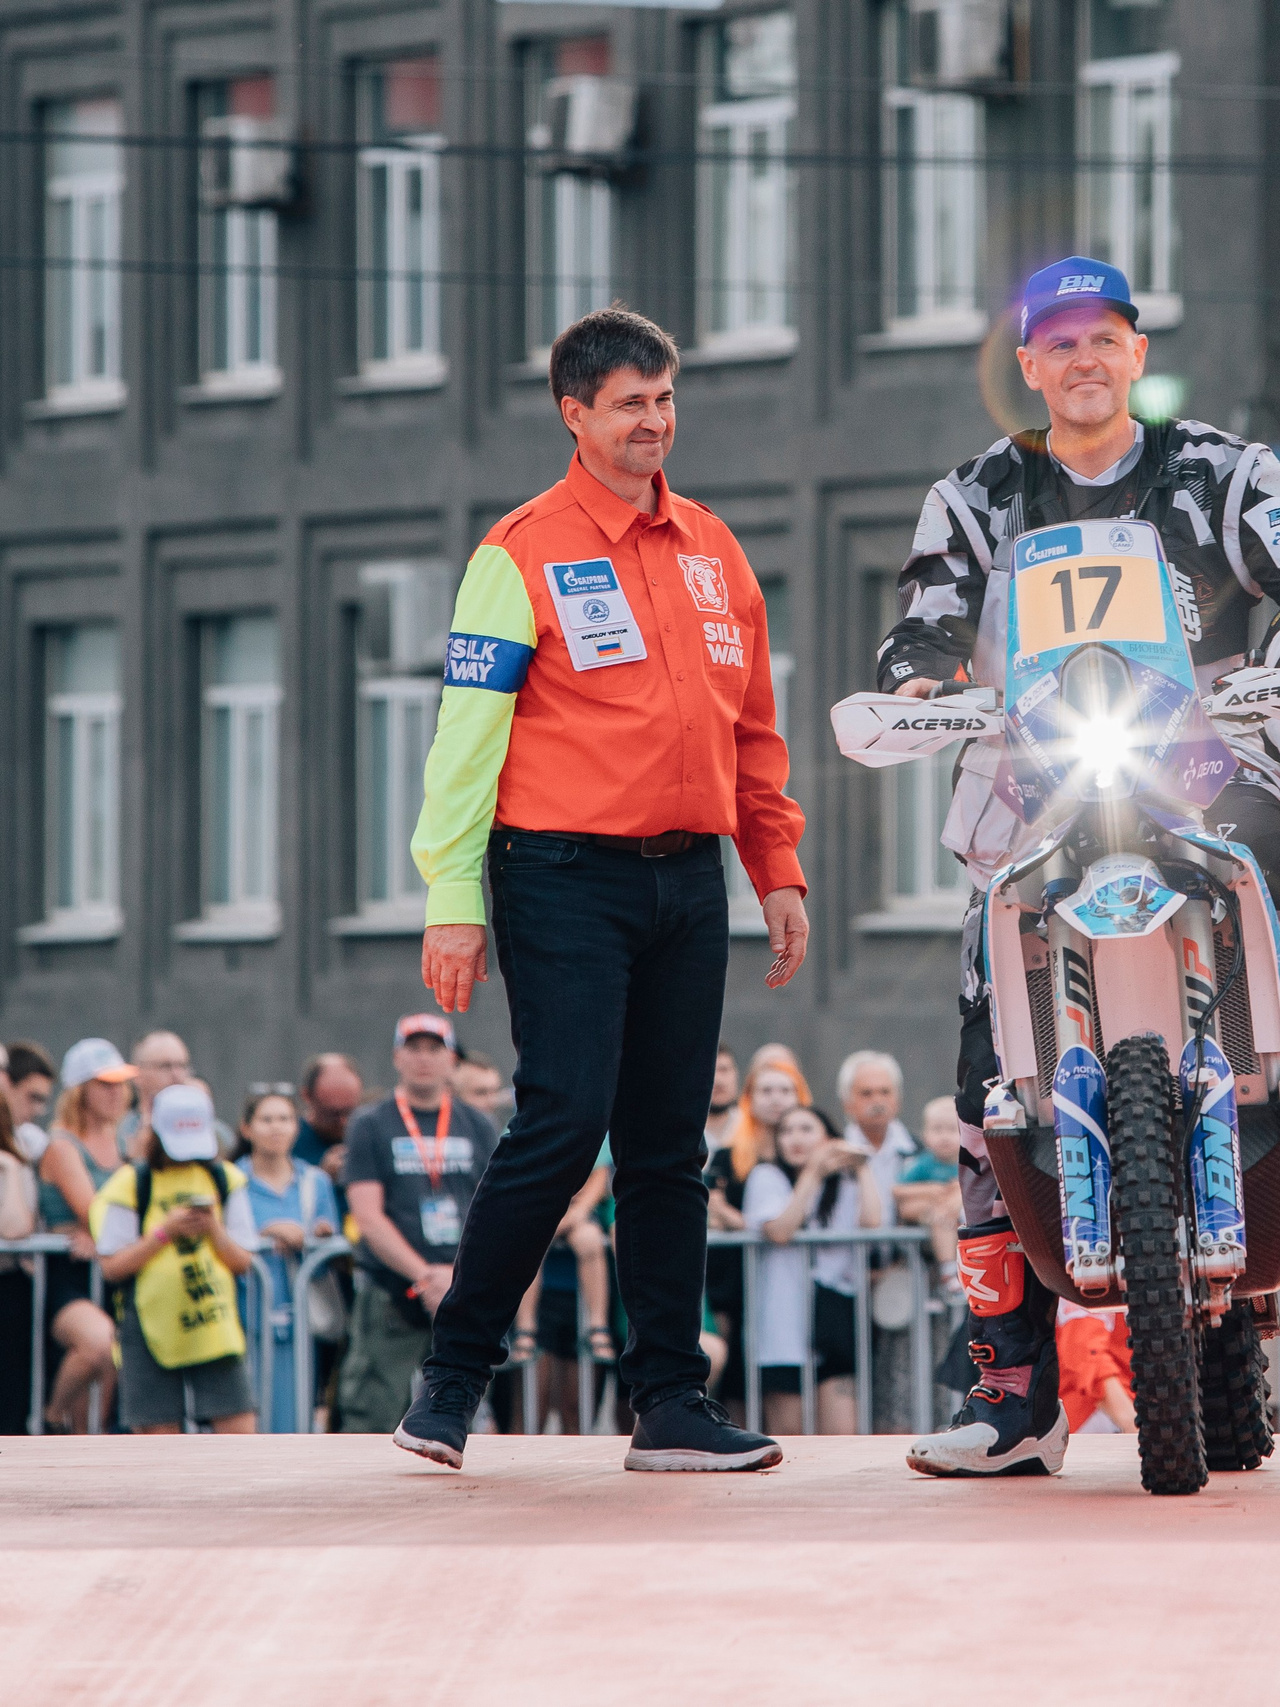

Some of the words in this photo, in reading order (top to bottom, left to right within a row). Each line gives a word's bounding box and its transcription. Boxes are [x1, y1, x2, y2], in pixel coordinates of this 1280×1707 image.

[1056, 287, 1101, 296] RACING
[1059, 275, 1106, 289] BN
[1036, 544, 1068, 561] GAZPROM
[577, 574, 609, 585] GAZPROM
[1050, 565, 1122, 634] 17
[703, 621, 744, 647] SILK
[451, 638, 499, 662] SILK
[706, 642, 744, 668] WAY
[450, 660, 495, 682] WAY
[892, 718, 987, 731] ACERBIS
[1155, 733, 1171, 759] RENE
[1165, 708, 1183, 740] ANTON
[1020, 725, 1037, 746] RENE
[1031, 743, 1054, 769] ANTON
[1197, 760, 1224, 780] ДЕЛО
[1073, 1065, 1102, 1077] ЛОГИН
[1202, 1115, 1236, 1207] BN
[1231, 1130, 1243, 1216] RACING
[1055, 1137, 1068, 1218] RACING
[1061, 1136, 1097, 1220] BN
